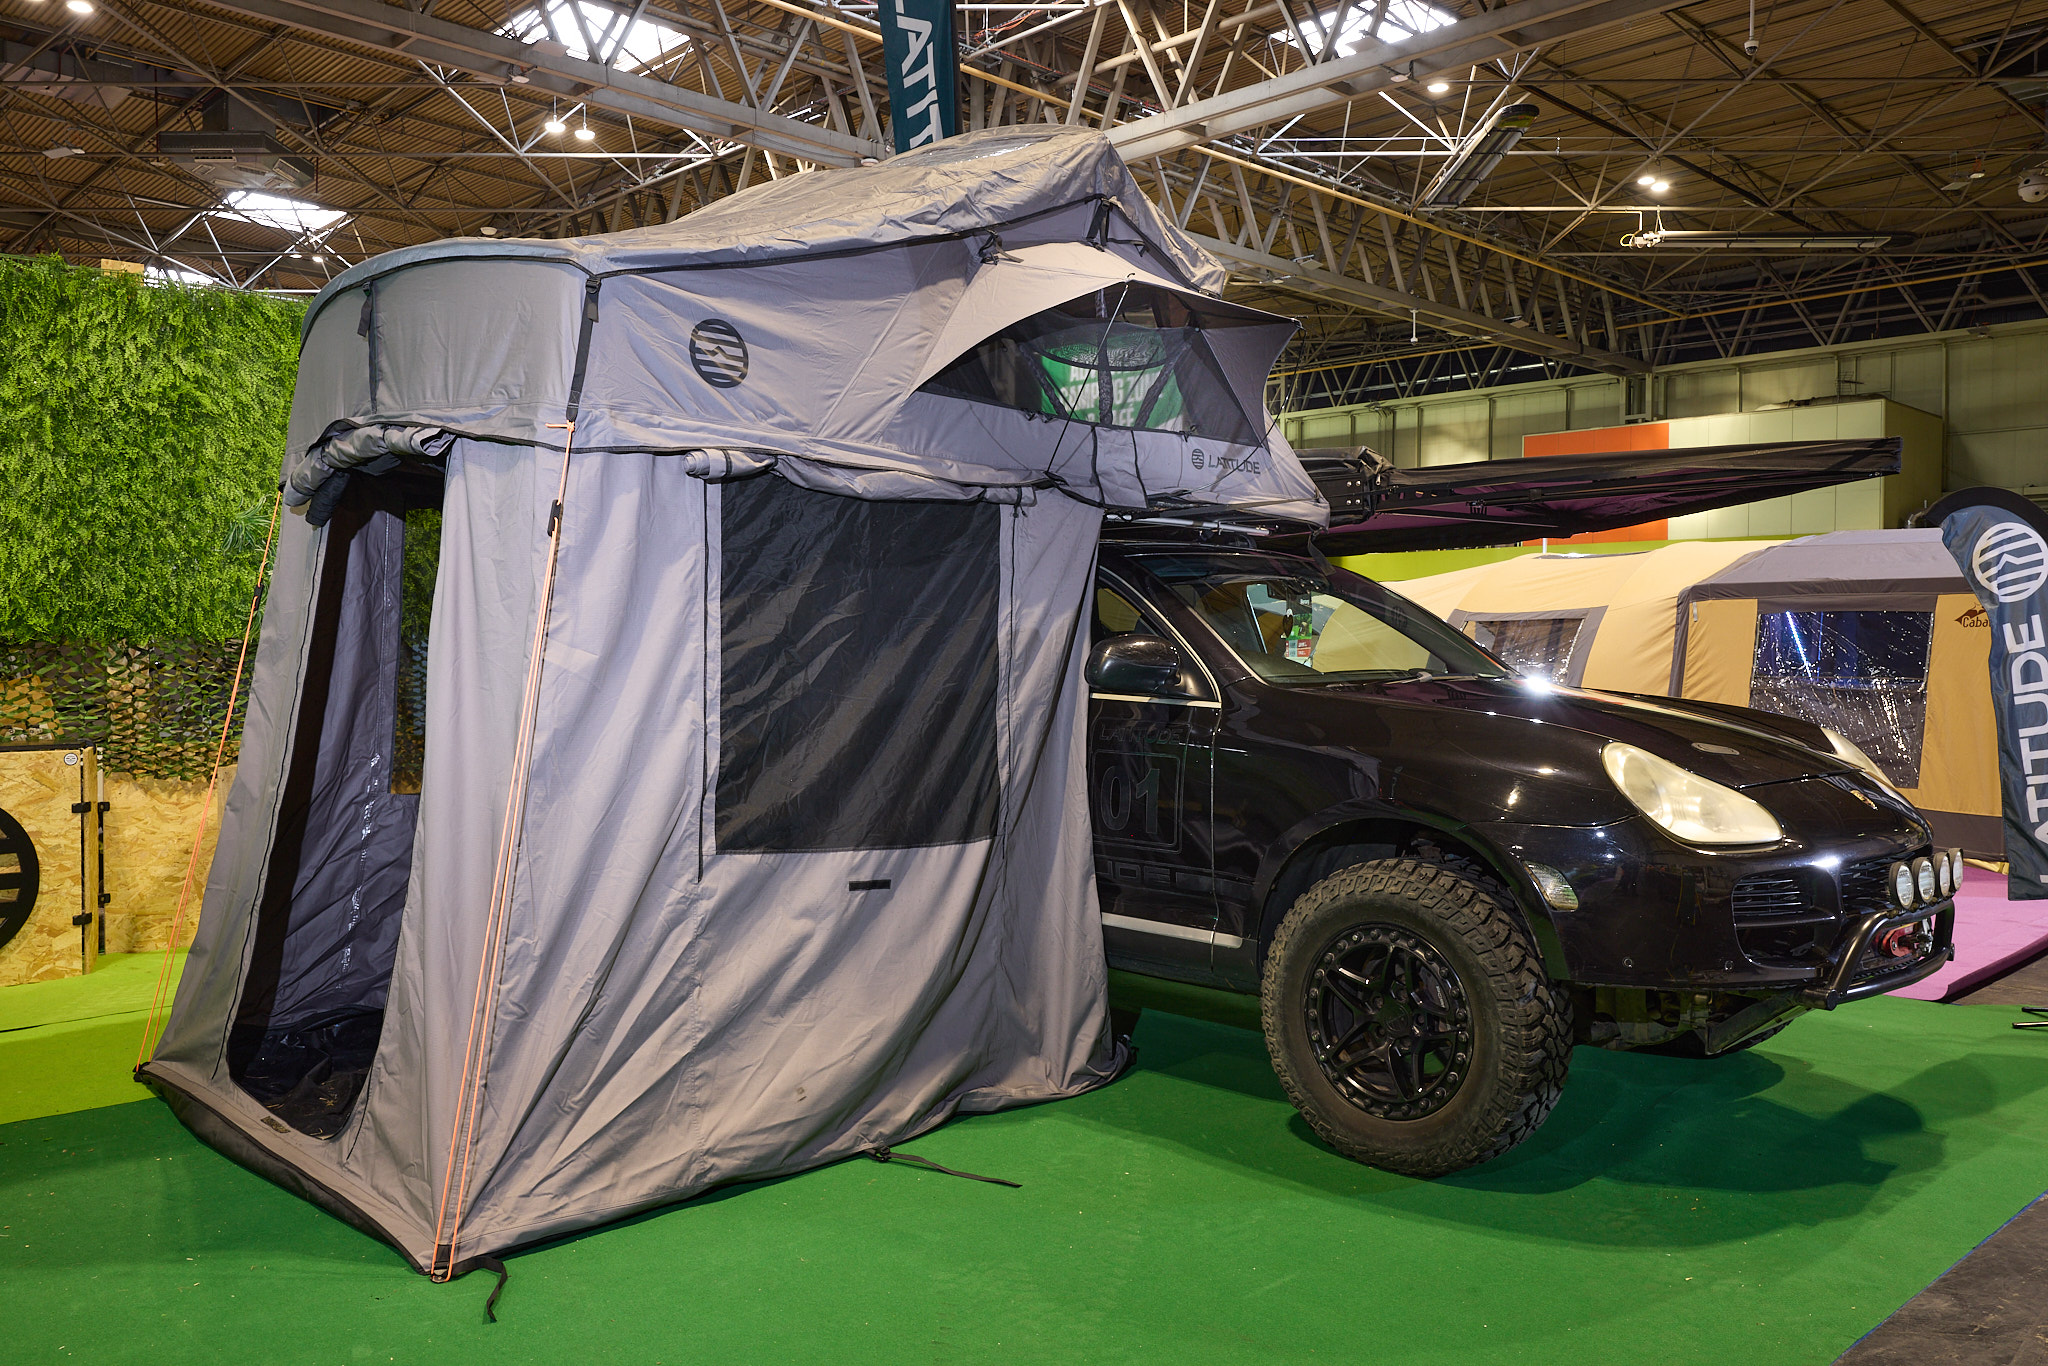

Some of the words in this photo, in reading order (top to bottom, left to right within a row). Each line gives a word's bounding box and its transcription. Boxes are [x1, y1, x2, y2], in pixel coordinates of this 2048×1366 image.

[895, 0, 944, 149] ATIT
[1207, 454, 1261, 475] LATITUDE
[1101, 765, 1160, 834] 01
[2002, 613, 2048, 884] TITUDE
